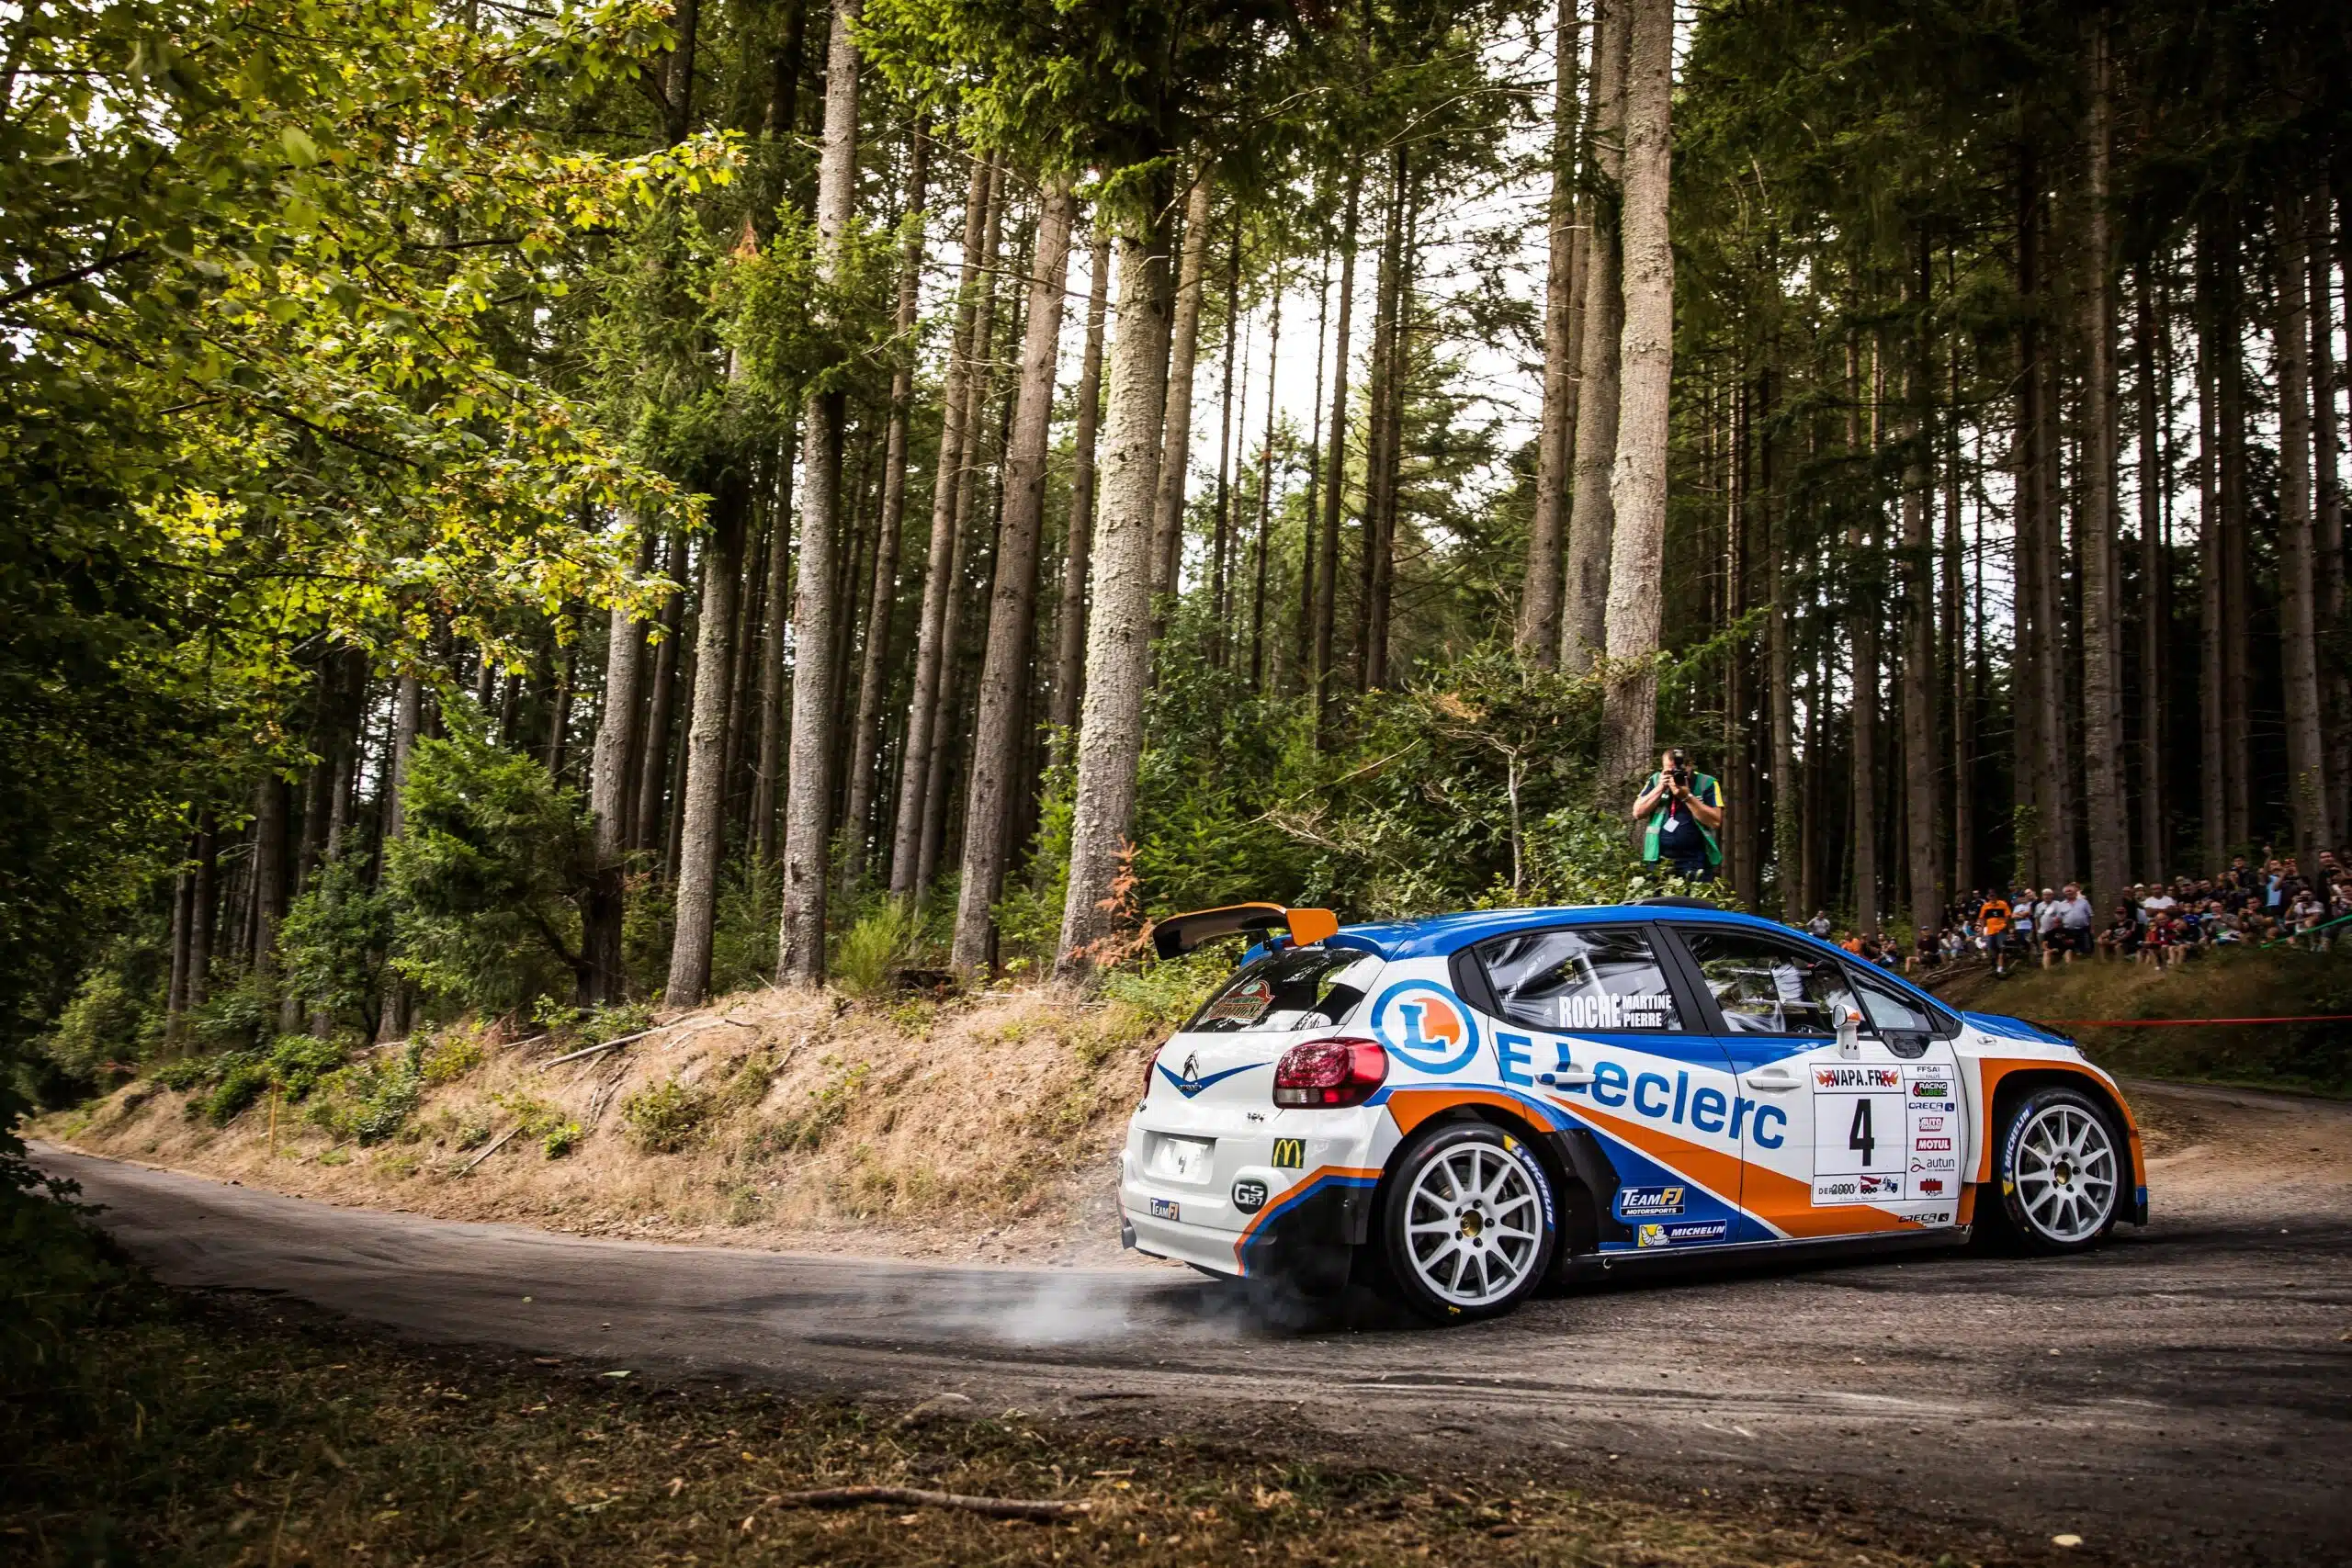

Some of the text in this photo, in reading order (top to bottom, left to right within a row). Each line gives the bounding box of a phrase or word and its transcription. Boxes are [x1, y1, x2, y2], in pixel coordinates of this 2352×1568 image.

[1623, 995, 1672, 1010] MARTINE
[1623, 1012, 1662, 1027] PIERRE
[1849, 1099, 1874, 1167] 4
[2005, 1109, 2030, 1168] MICHELIN
[1917, 1140, 1949, 1149] MOTUL
[1927, 1157, 1954, 1168] autun
[1670, 1225, 1725, 1236] MICHELIN
